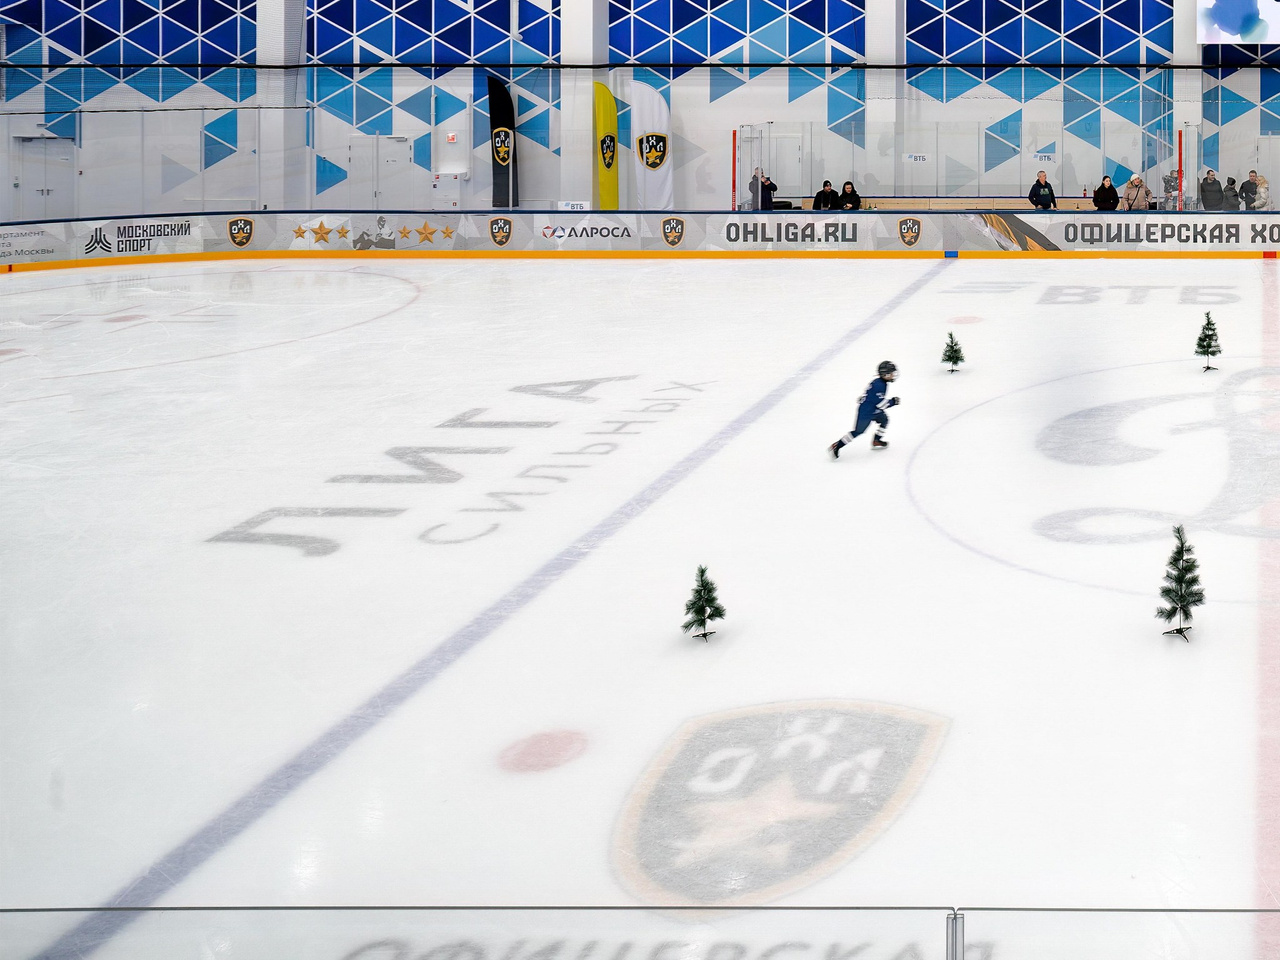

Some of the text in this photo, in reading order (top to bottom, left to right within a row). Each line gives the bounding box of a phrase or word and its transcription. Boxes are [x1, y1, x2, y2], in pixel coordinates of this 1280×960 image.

[117, 220, 191, 239] МОСКОВСКИЙ
[567, 226, 631, 238] АЛРОСА
[726, 222, 858, 243] OHLIGA.RU
[1064, 222, 1240, 245] ОФИЦЕРСКАЯ
[14, 248, 54, 256] Москвы
[117, 238, 152, 253] СПОРТ
[1035, 285, 1242, 305] ВТБ
[202, 374, 640, 557] ЛИГА
[417, 380, 719, 546] СИЛЬНЫХ
